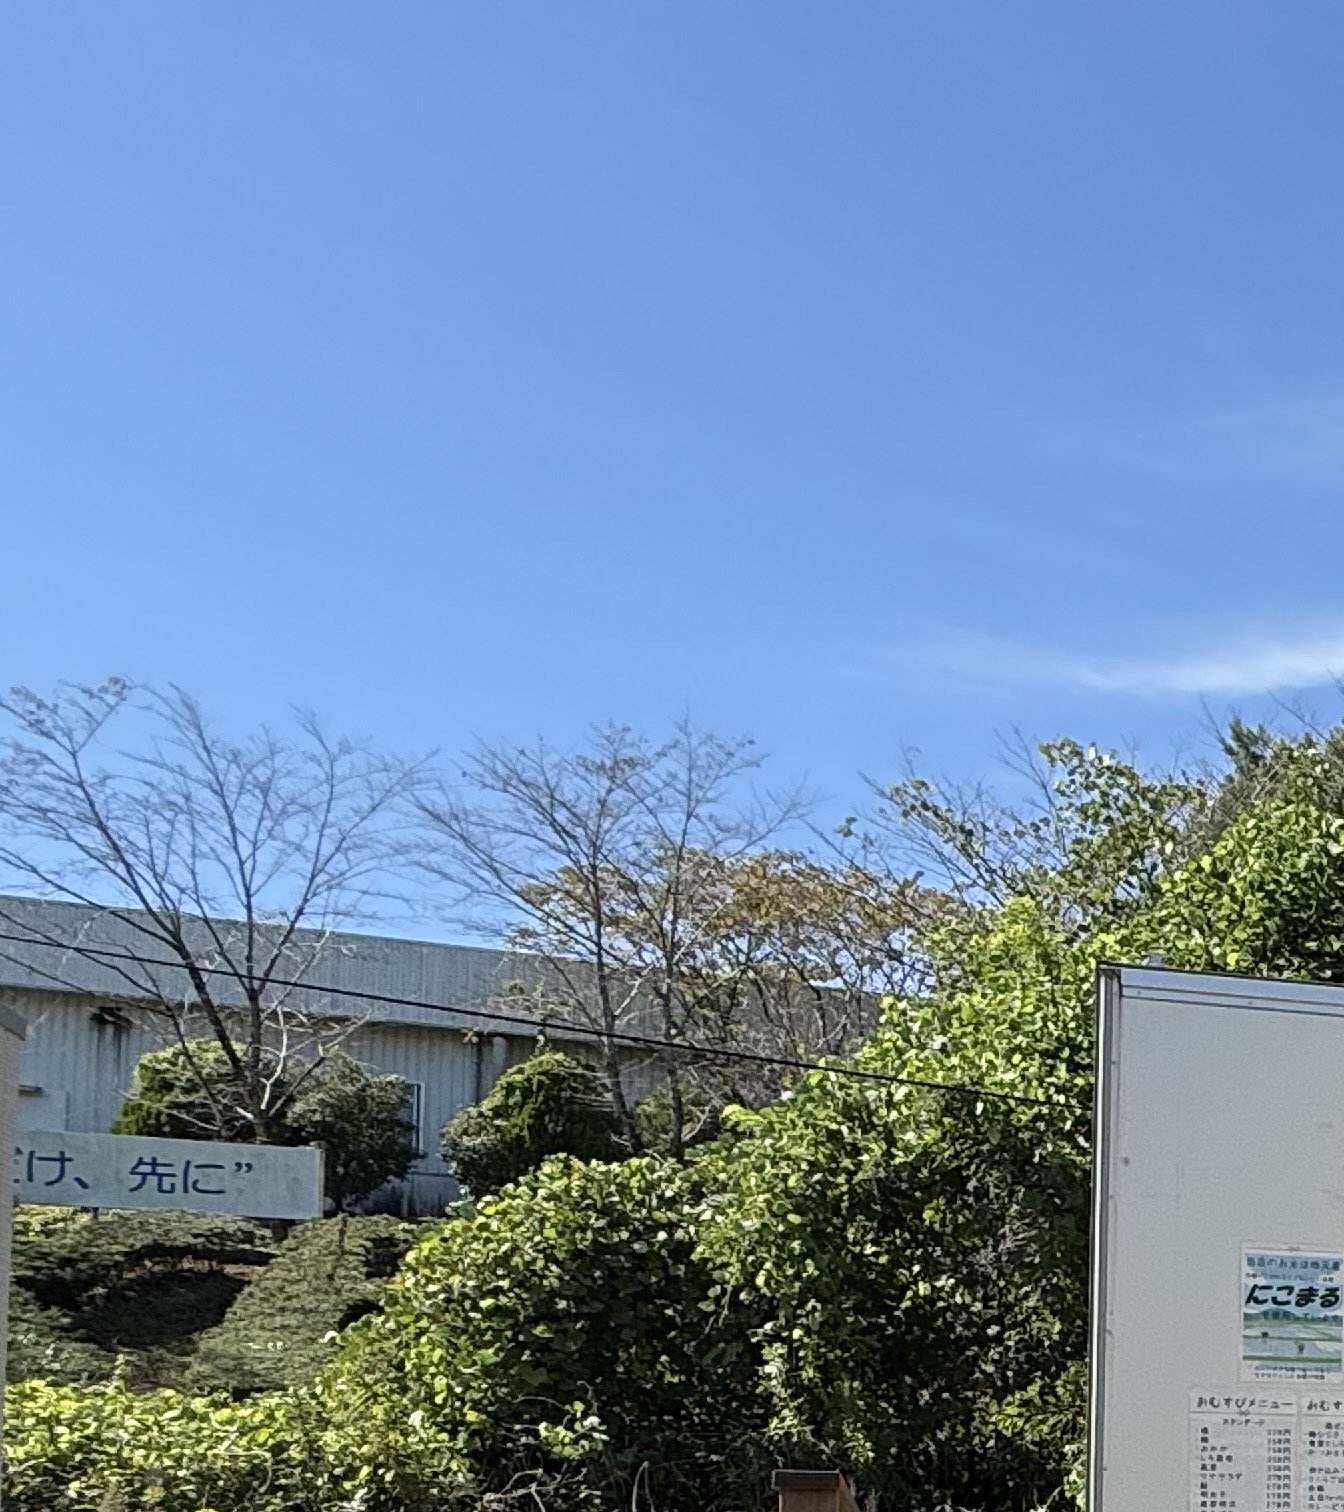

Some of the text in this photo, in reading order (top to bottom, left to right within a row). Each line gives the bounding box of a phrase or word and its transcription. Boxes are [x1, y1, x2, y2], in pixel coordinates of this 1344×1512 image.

[1245, 1283, 1340, 1309] にこまる
[1196, 1395, 1294, 1409] おむすびメニュー
